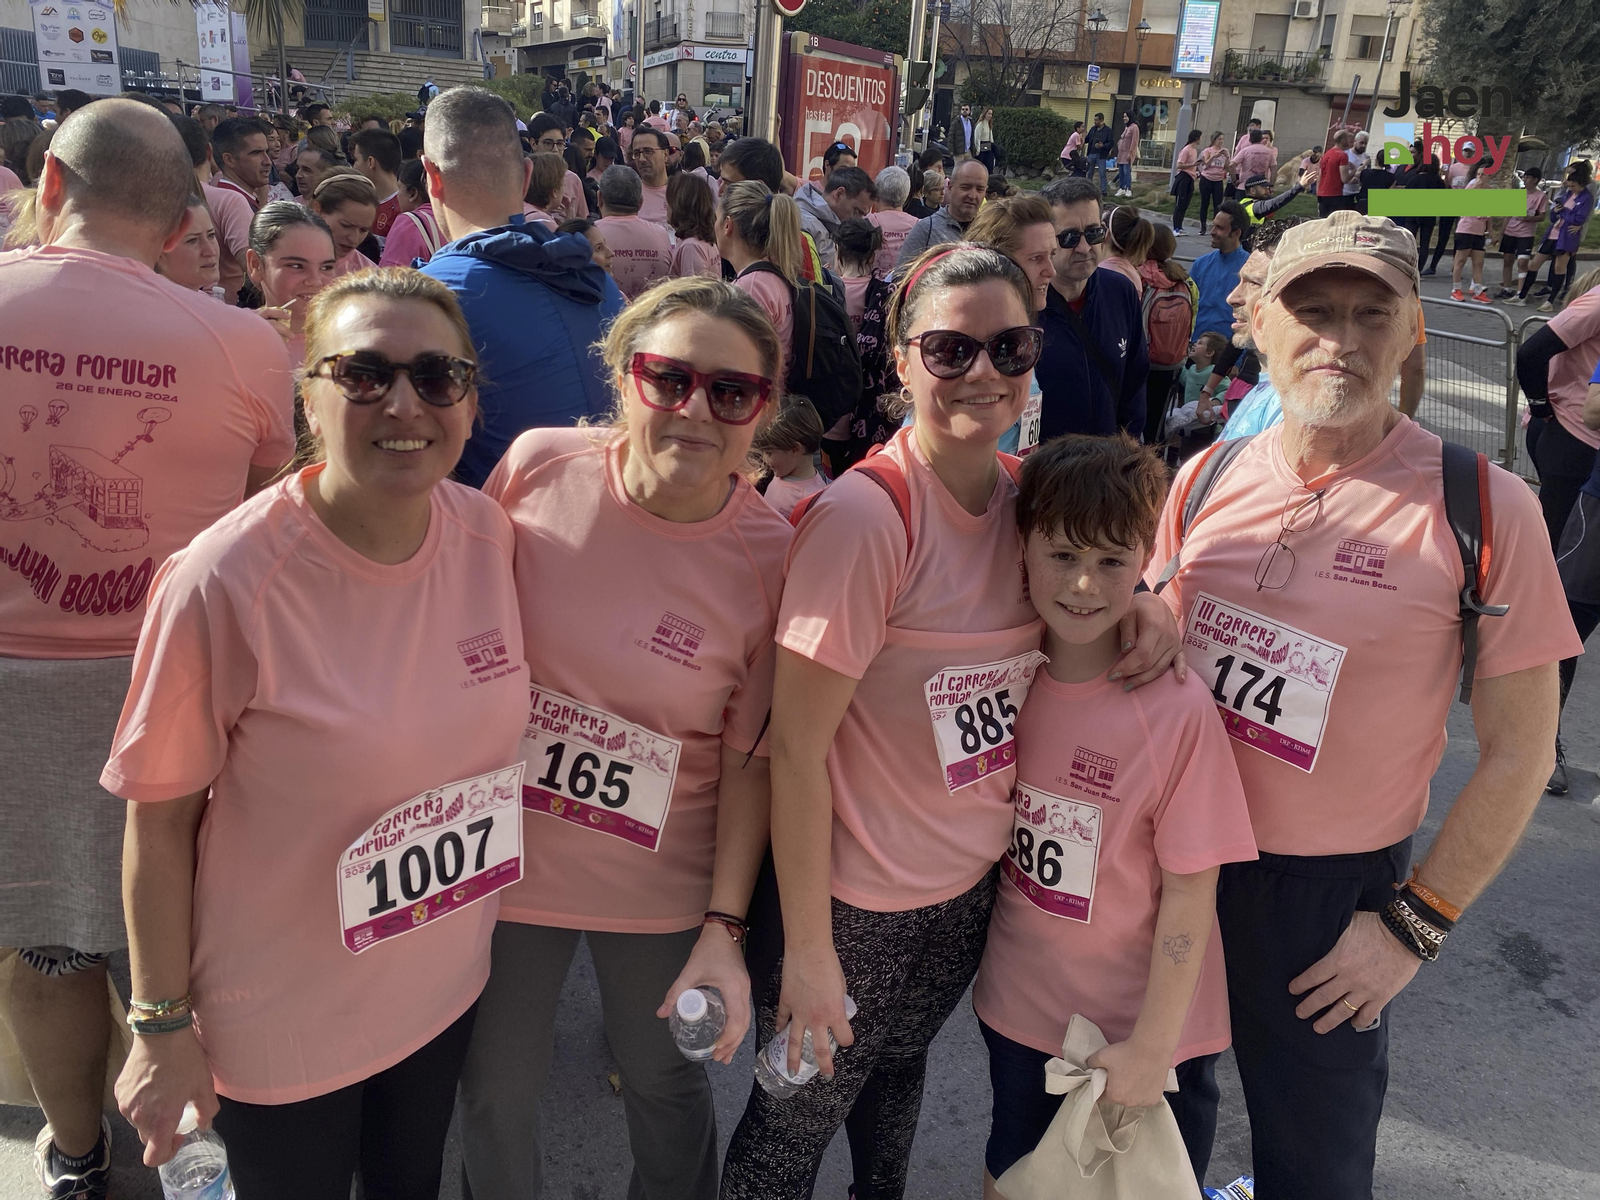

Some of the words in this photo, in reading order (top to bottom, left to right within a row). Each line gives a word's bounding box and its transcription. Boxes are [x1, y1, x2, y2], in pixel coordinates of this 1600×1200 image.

[810, 36, 819, 47] 1B
[704, 51, 738, 60] centro
[806, 69, 887, 105] DESCUENTOS
[805, 106, 826, 122] hasta
[1303, 235, 1355, 251] Reebok
[56, 382, 74, 391] 28
[77, 385, 95, 393] DE
[97, 387, 142, 398] ENERO
[145, 392, 179, 402] 2024
[8, 542, 61, 604] JUAN
[59, 557, 155, 616] BOSCO
[1333, 573, 1348, 582] San
[1350, 577, 1370, 587] Juan
[1372, 580, 1398, 591] Bosco
[1197, 600, 1216, 621] III
[1186, 638, 1208, 651] 2024
[650, 645, 664, 656] San
[664, 652, 682, 664] Juan
[682, 659, 702, 671] Bosco
[1210, 654, 1287, 726] 174
[955, 688, 1018, 755] 885
[537, 741, 634, 809] 165
[1070, 781, 1083, 791] San
[1083, 787, 1100, 797] Juan
[1101, 792, 1121, 803] Bosco
[345, 864, 371, 879] 2024
[366, 815, 495, 917] 1007
